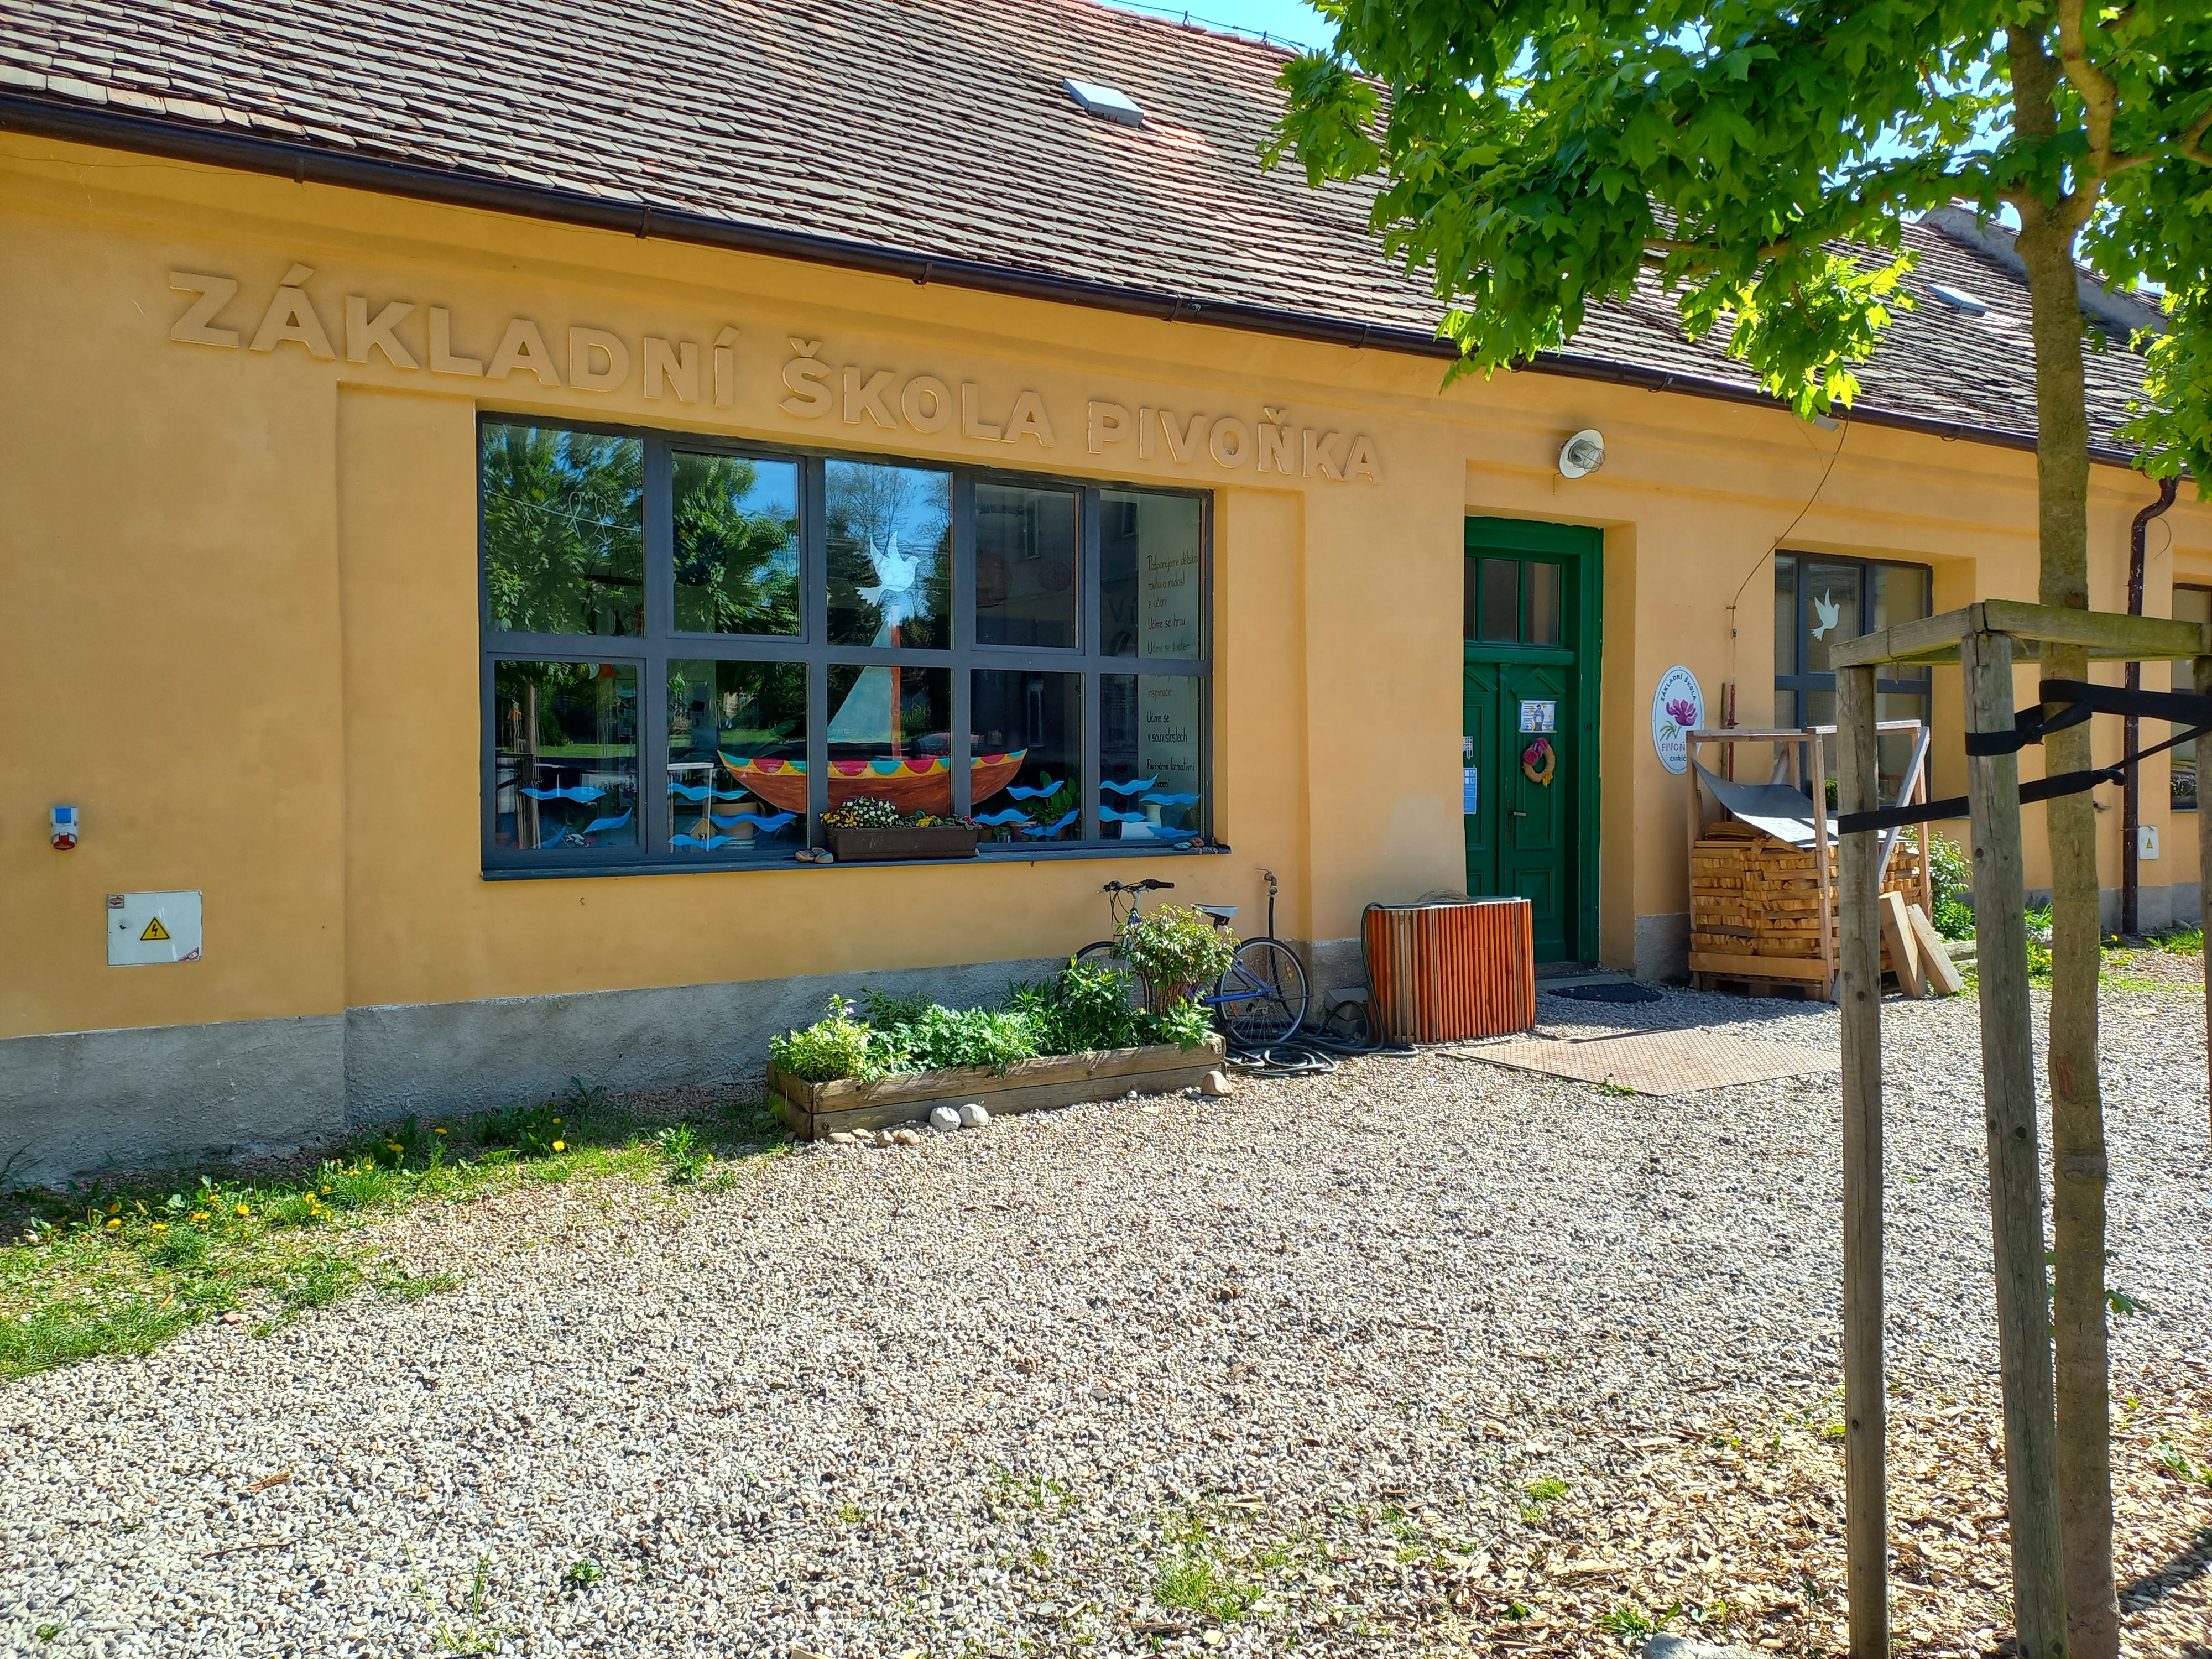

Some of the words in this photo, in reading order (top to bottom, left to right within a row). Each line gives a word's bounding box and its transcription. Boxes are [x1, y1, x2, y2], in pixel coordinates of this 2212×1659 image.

[169, 263, 740, 409] ZÁKLADNÍ
[779, 337, 1056, 449] ŠKOLA
[1086, 400, 1383, 486] PIVOŇKA
[1181, 547, 1199, 565] dětsko
[1147, 617, 1162, 630] Učíme
[1165, 619, 1171, 628] se
[1173, 613, 1186, 627] hrou
[1660, 673, 1683, 702] ZÁKLADNÍ
[1684, 676, 1697, 701] ŠKOLA
[1164, 714, 1170, 723] se
[1661, 741, 1686, 752] PIVOŇ
